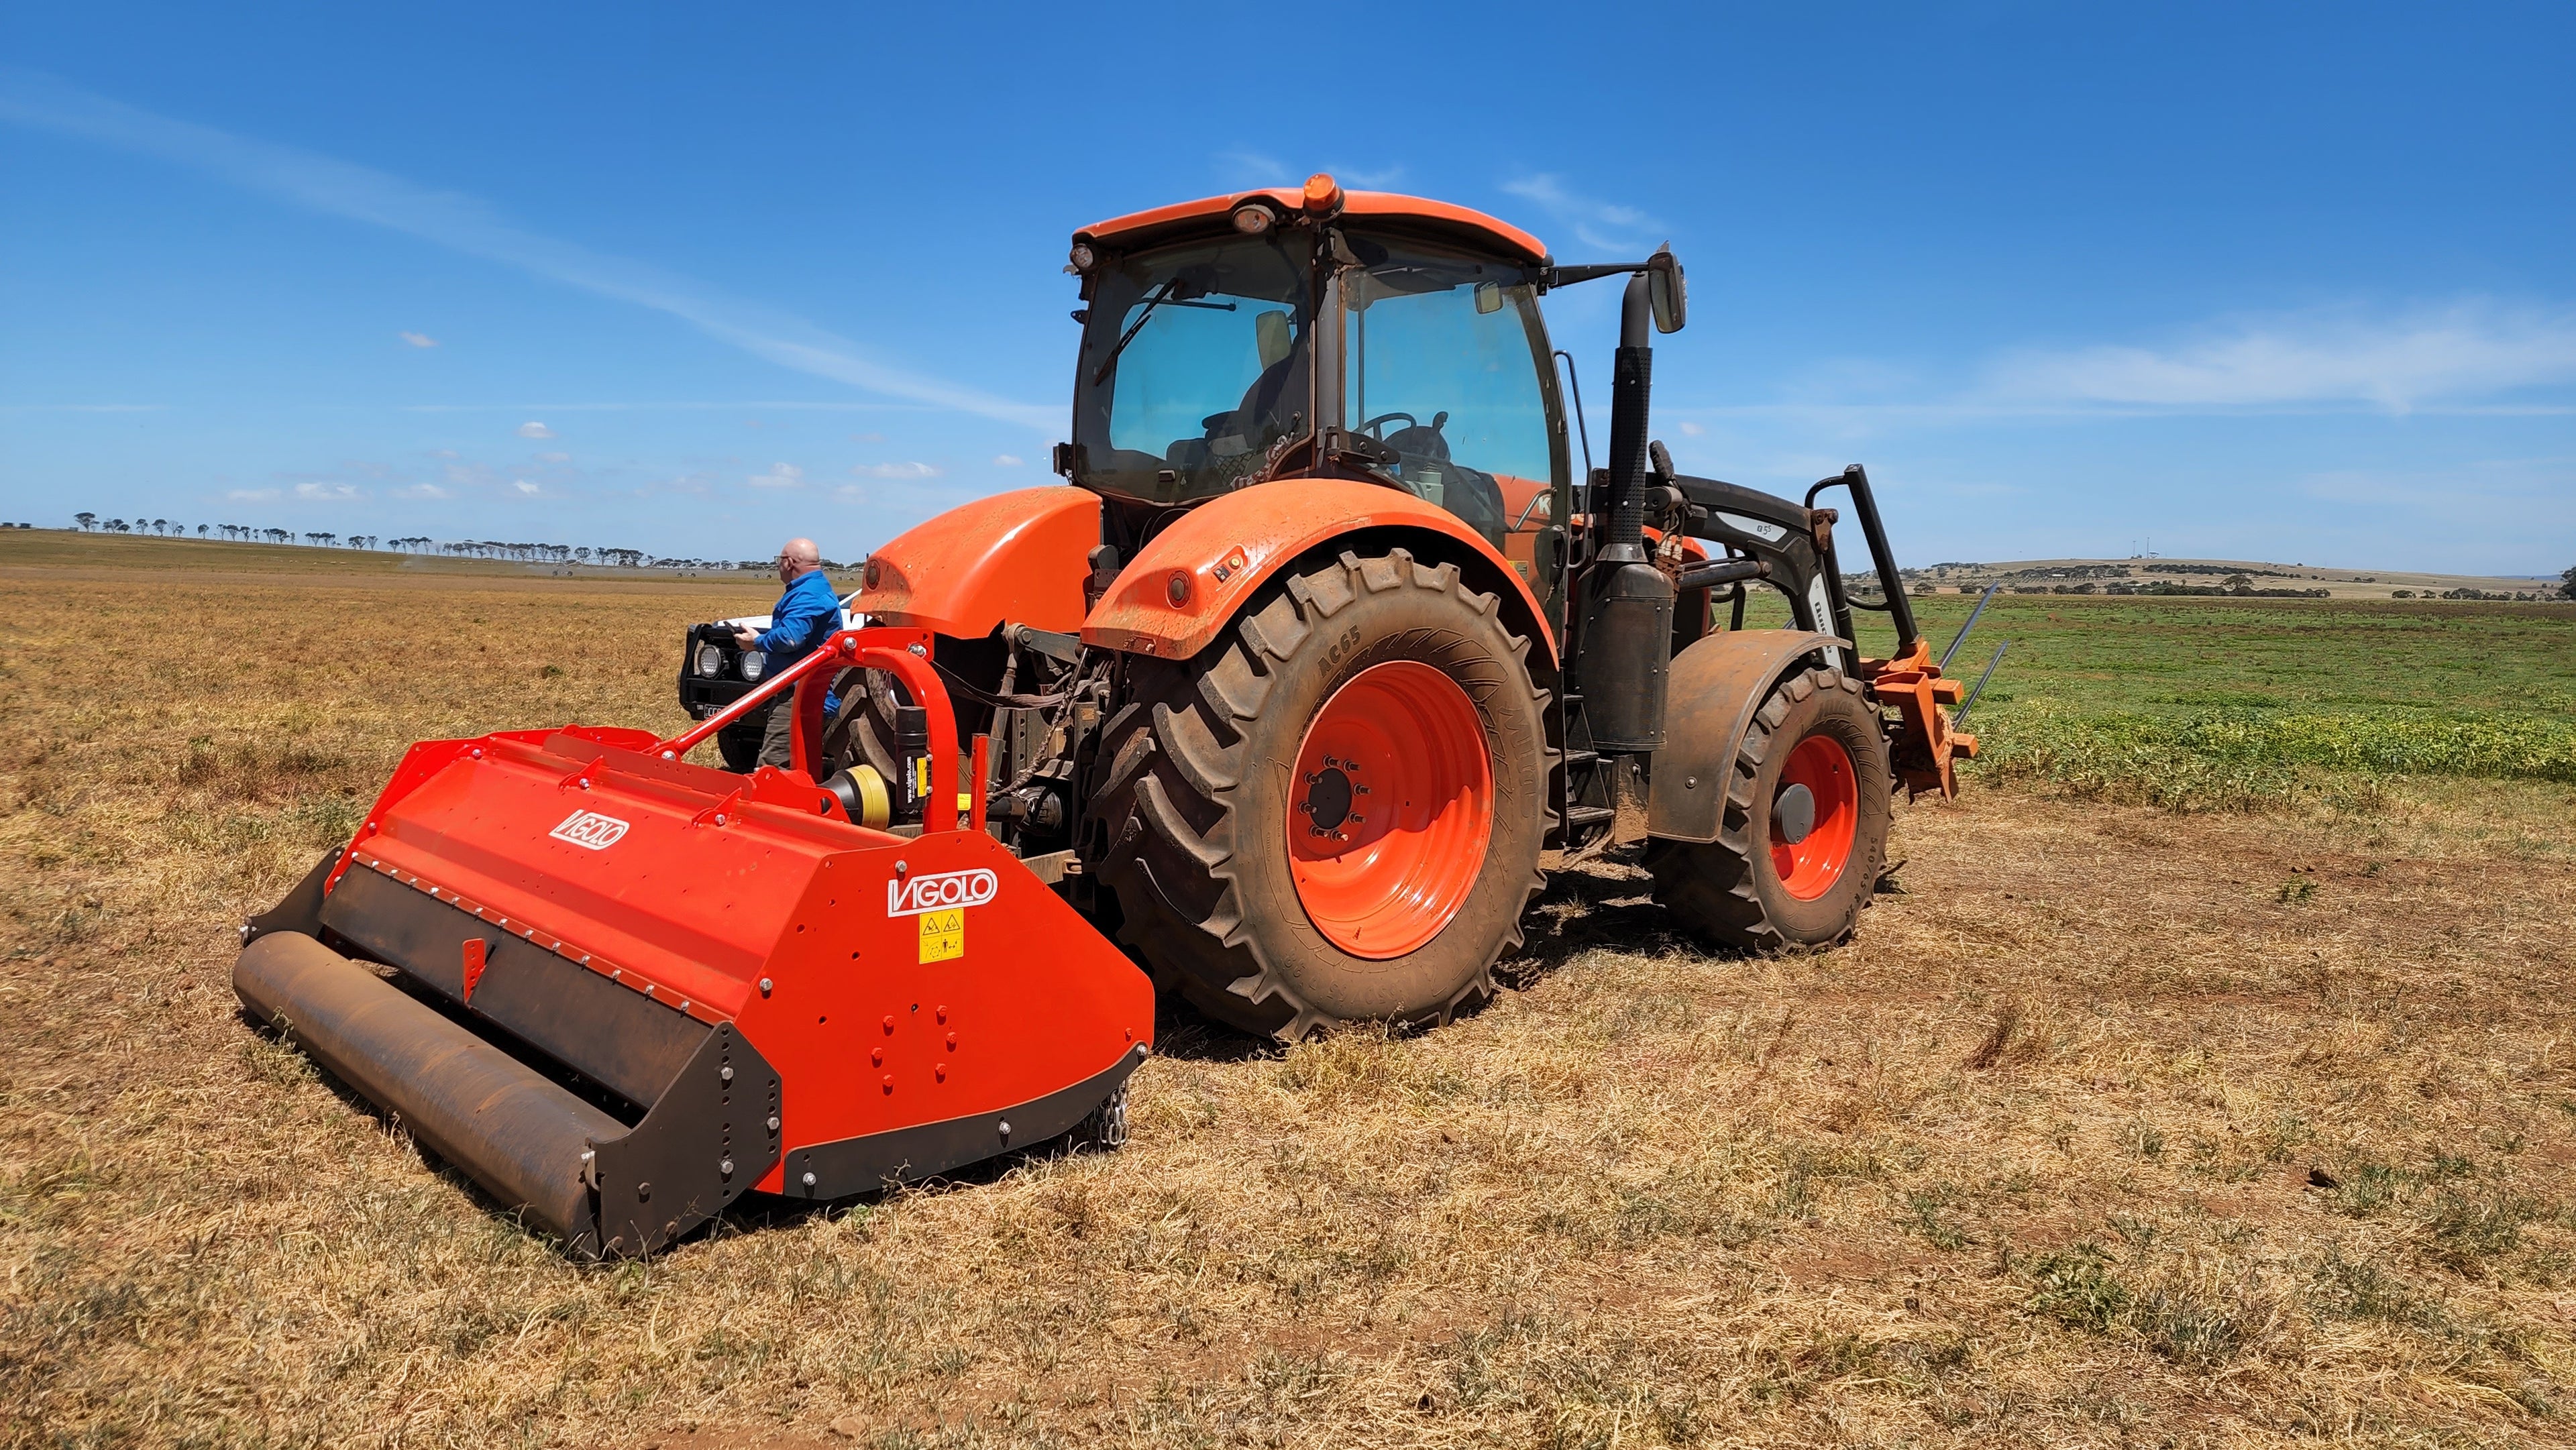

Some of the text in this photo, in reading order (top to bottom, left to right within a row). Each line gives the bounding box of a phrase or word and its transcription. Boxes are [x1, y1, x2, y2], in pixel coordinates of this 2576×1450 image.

[1317, 624, 1360, 679] AC65
[1815, 602, 1832, 654] Quice
[550, 809, 629, 849] VIGOLO
[1860, 837, 1878, 891] 540/65
[889, 870, 997, 915] VIGOLO
